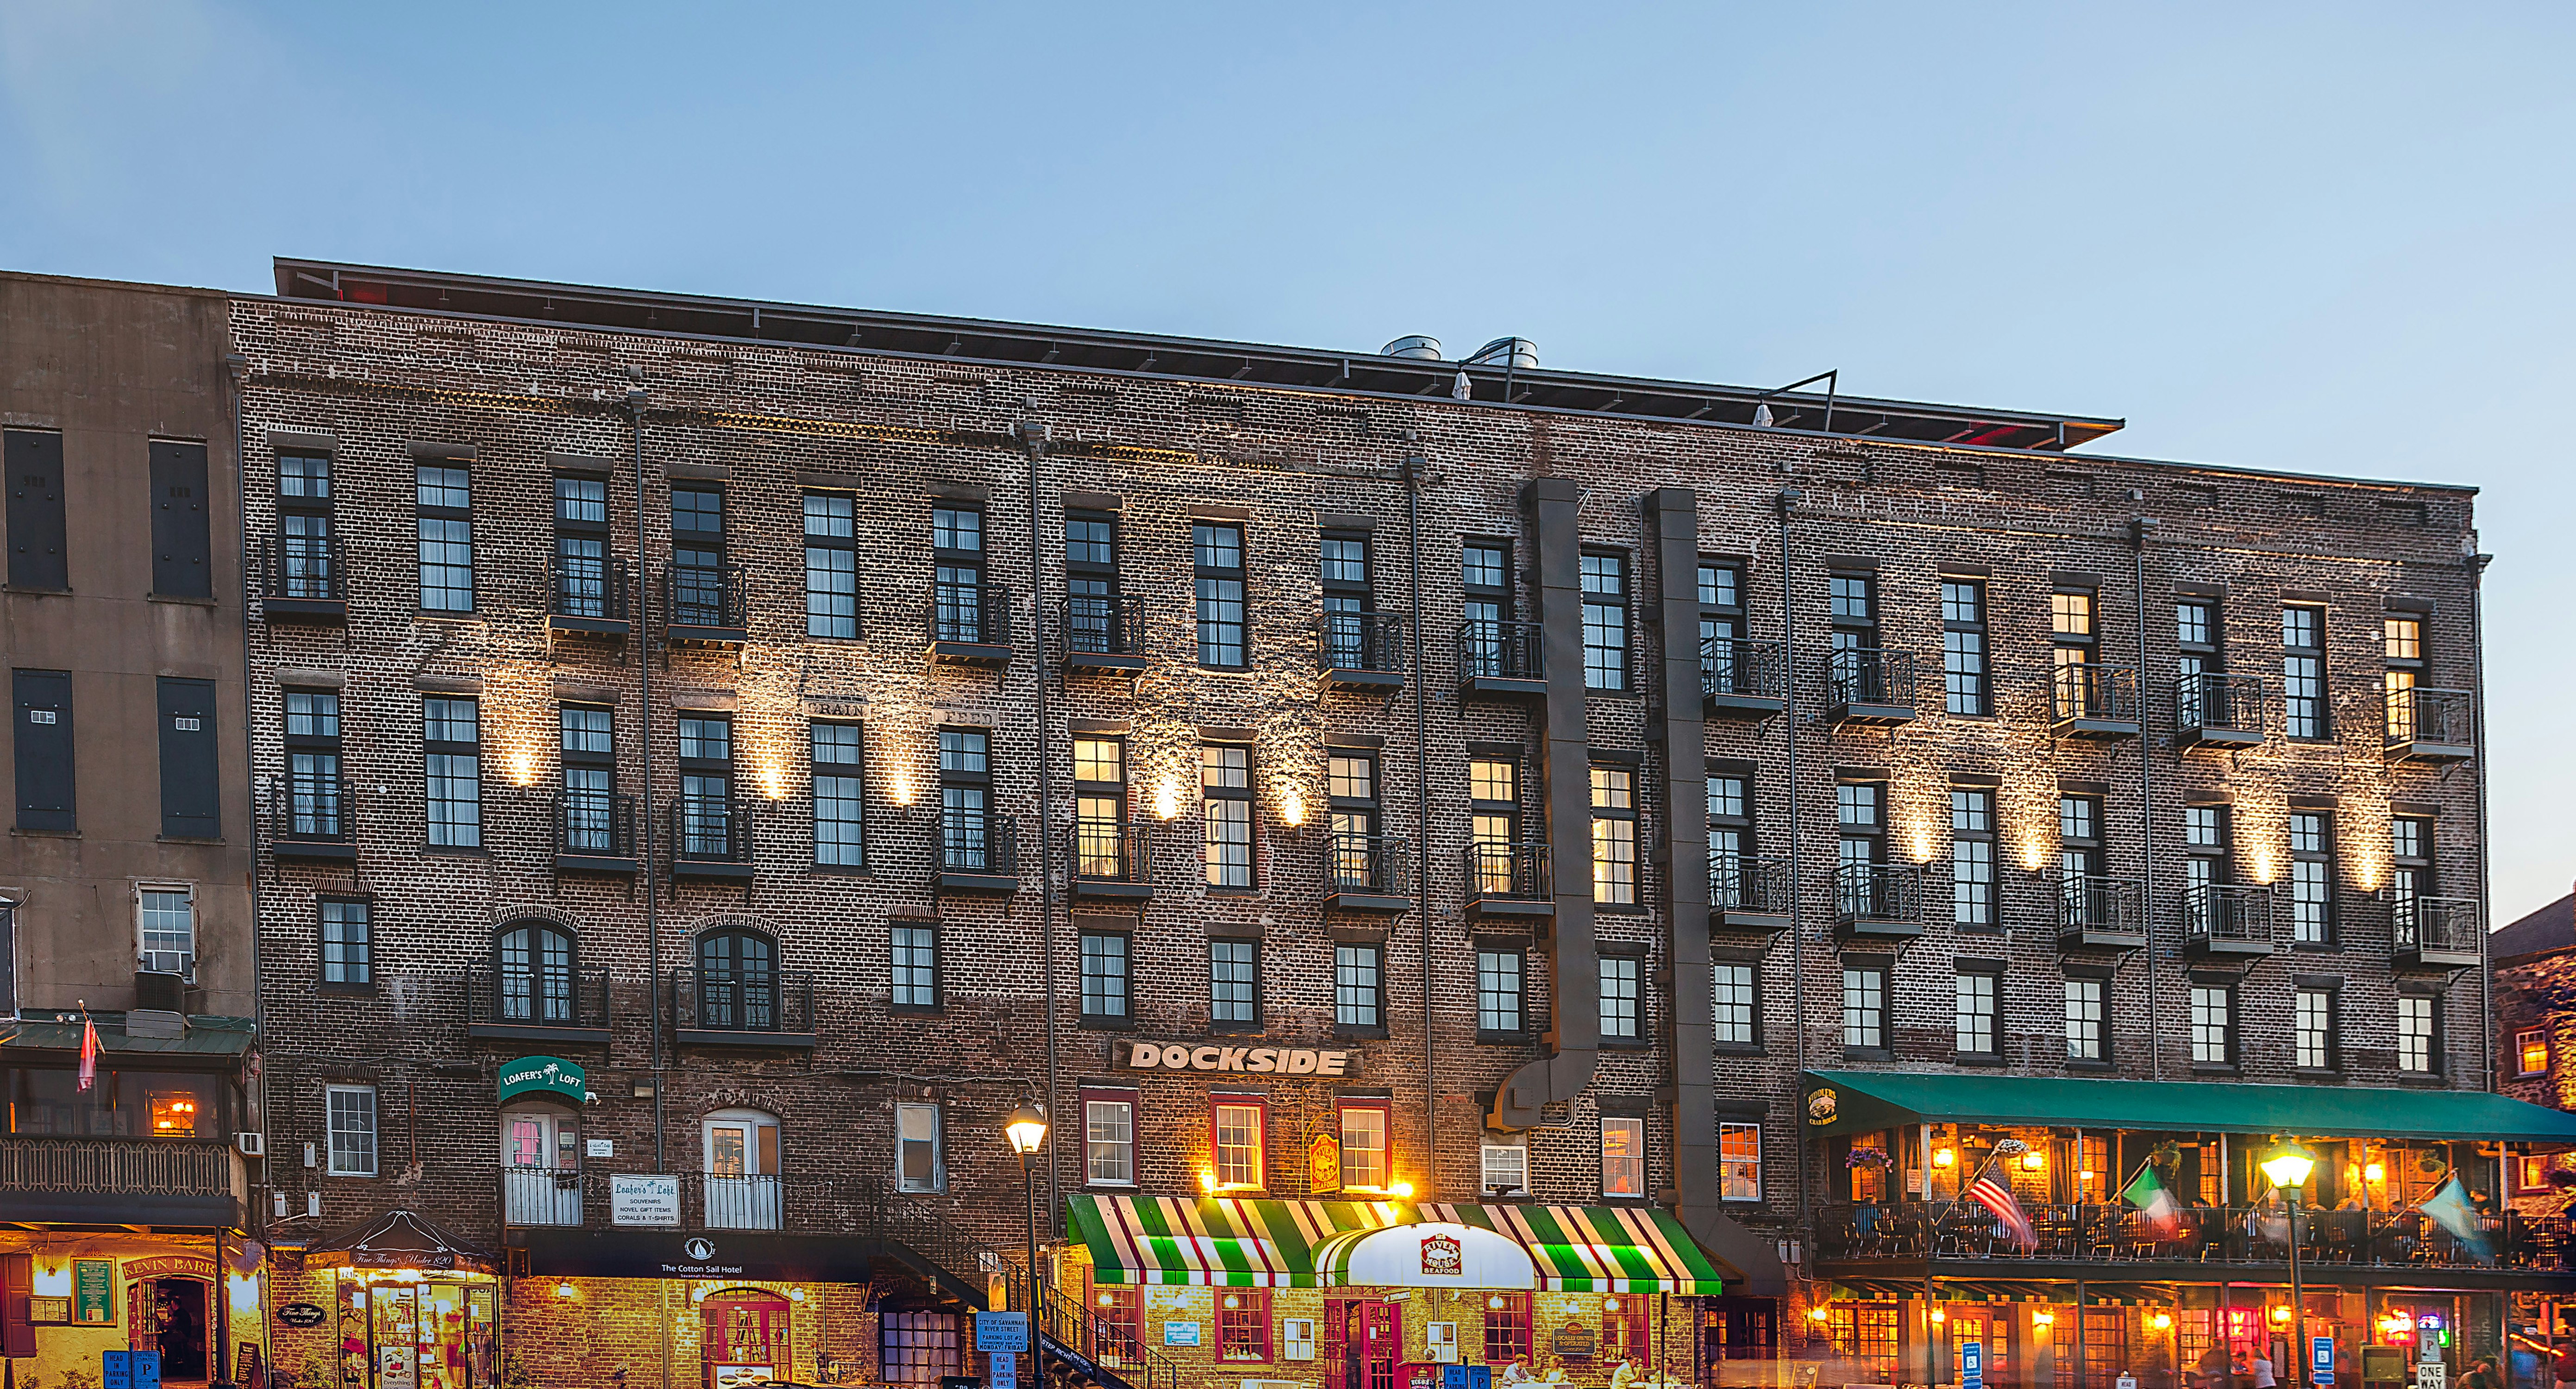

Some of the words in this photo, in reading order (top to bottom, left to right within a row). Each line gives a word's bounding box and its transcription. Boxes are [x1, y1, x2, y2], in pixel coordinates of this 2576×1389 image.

[1130, 1043, 1347, 1075] DOCKSIDE
[503, 1070, 542, 1086] LOAFER'S
[559, 1073, 582, 1087] LOFT
[615, 1184, 646, 1195] Loafer's
[657, 1185, 674, 1196] Loft
[1313, 1179, 1337, 1190] SEAFOOD
[1424, 1241, 1457, 1253] RIVER
[353, 1252, 372, 1263] Fine
[373, 1252, 397, 1267] Things
[406, 1253, 432, 1264] Under
[433, 1255, 451, 1264] $20
[1426, 1257, 1456, 1267] HOUSE
[123, 1258, 168, 1276] KEVIN
[1041, 1339, 1055, 1350] STEP
[1055, 1348, 1071, 1360] RIGHT
[2426, 1340, 2434, 1350] P
[142, 1364, 151, 1376] P
[2420, 1367, 2442, 1377] ONE
[1477, 1377, 1485, 1388] P
[2420, 1380, 2442, 1389] WAY
